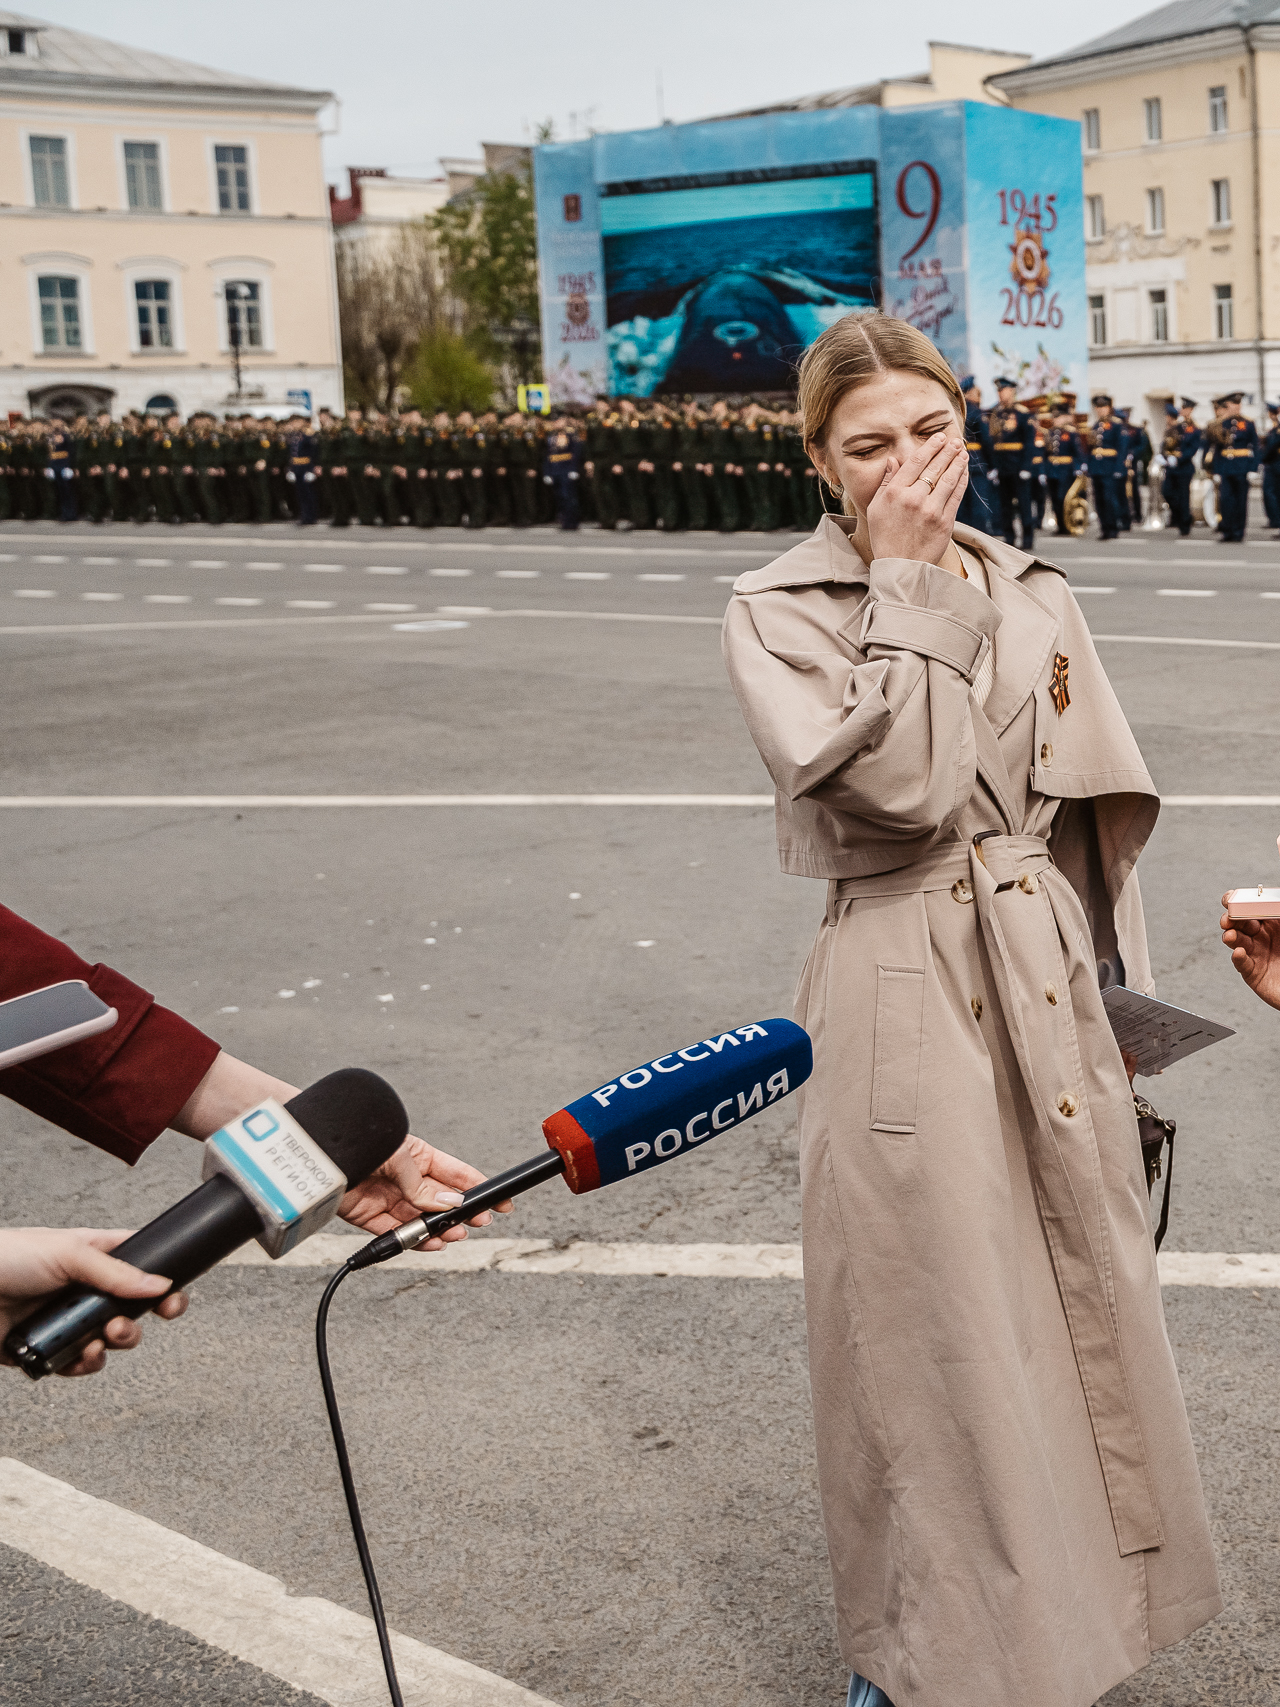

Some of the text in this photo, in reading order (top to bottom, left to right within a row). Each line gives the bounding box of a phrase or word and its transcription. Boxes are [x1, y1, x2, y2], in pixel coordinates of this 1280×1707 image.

[895, 160, 942, 261] 9
[997, 188, 1058, 233] 1945
[999, 288, 1064, 329] 2026
[591, 1024, 768, 1108] РОССИЯ
[625, 1068, 789, 1171] РОССИЯ
[265, 1146, 318, 1202] РЕГИОН
[282, 1132, 334, 1190] ТВЕРСКОЙ
